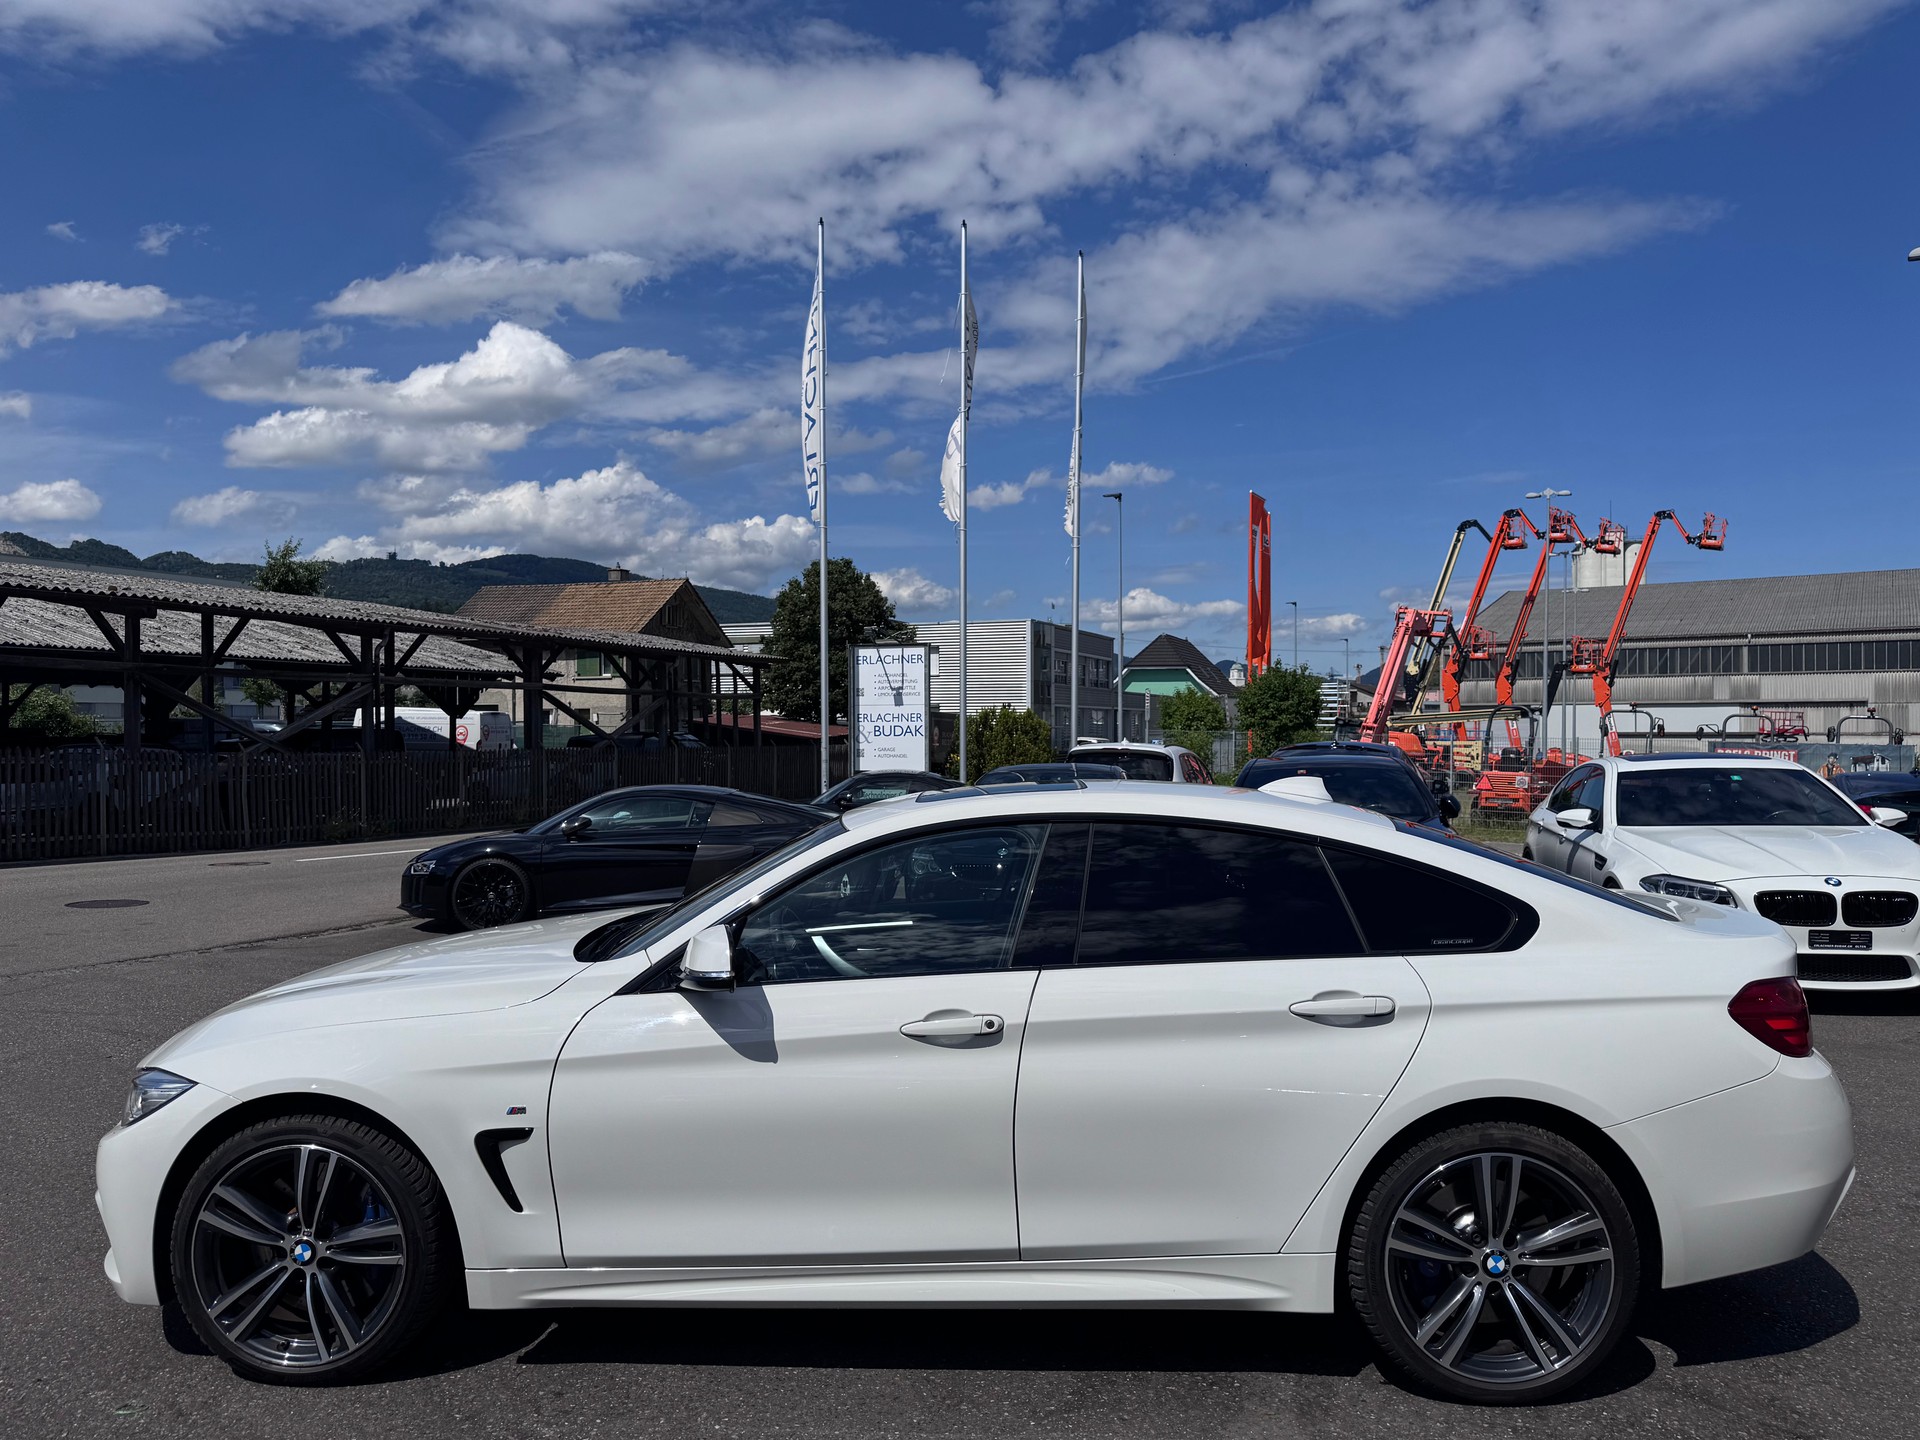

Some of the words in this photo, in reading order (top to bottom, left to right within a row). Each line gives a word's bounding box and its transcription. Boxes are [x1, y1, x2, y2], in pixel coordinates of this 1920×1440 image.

[856, 654, 924, 665] ERLACHNER
[857, 713, 923, 723] ERLACHNER
[856, 725, 873, 744] &
[873, 725, 924, 737] BUDAK
